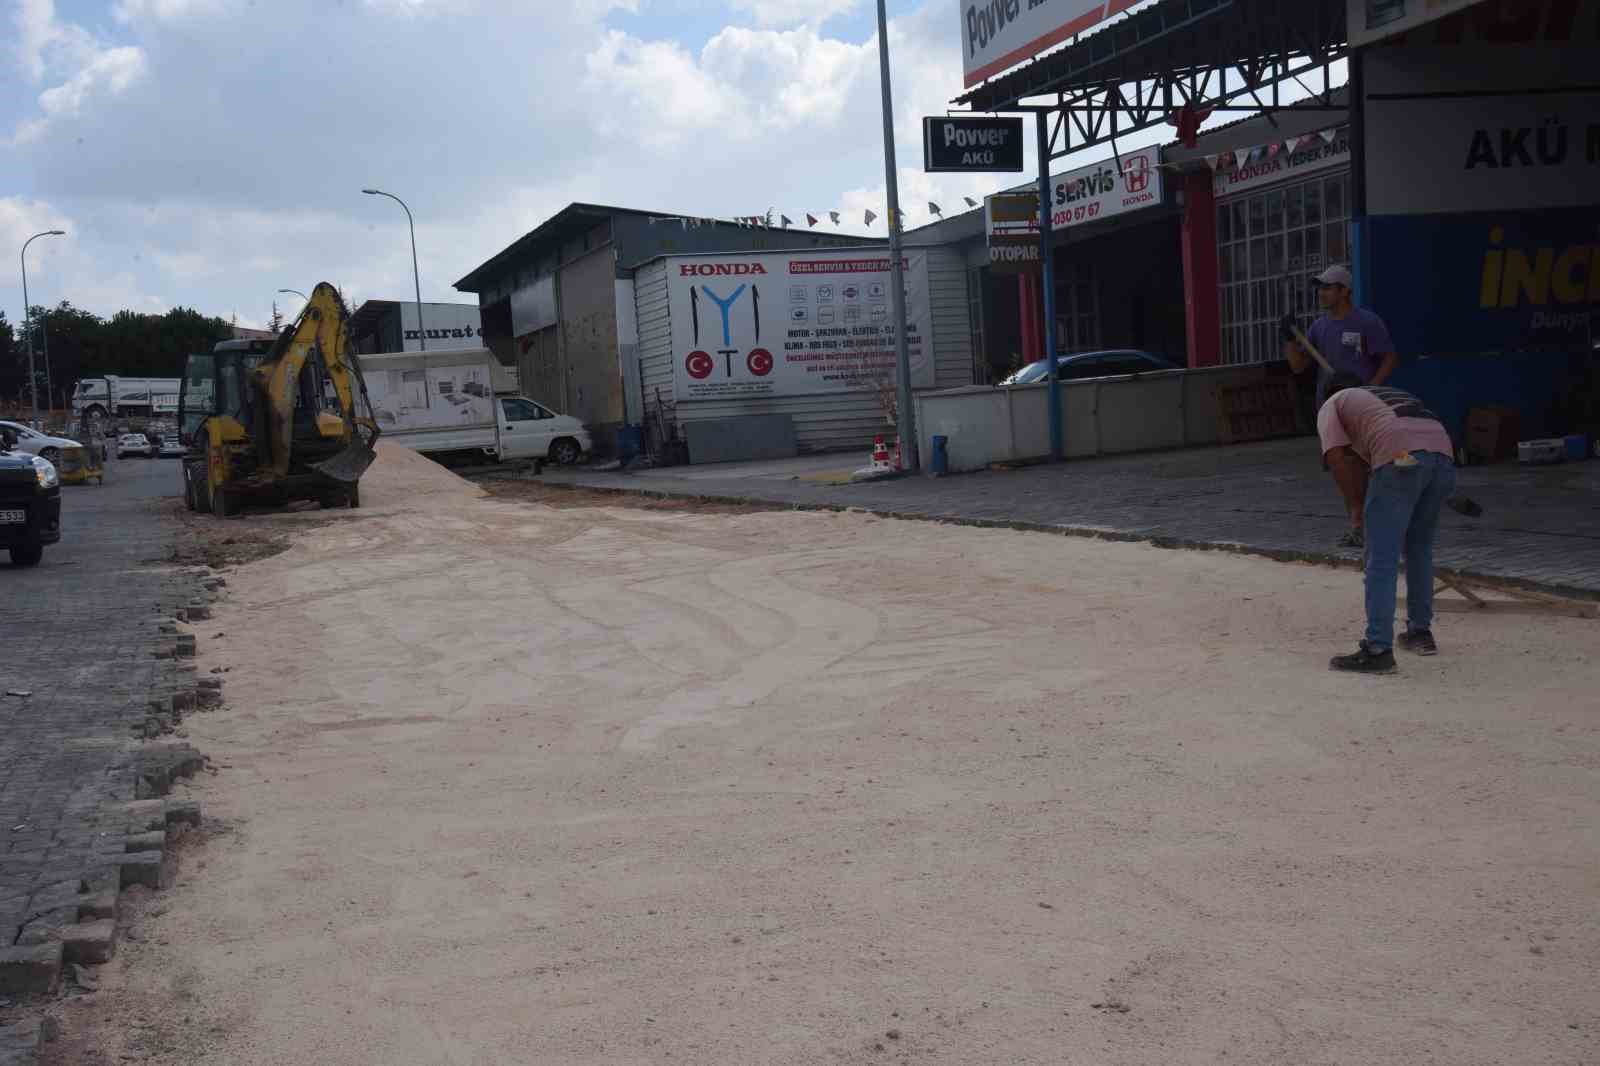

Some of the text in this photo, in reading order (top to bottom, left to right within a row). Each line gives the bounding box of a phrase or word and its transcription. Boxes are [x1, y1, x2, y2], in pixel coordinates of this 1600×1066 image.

[1464, 111, 1569, 170] AKÜ
[961, 149, 994, 165] AKÜ
[1229, 160, 1282, 184] HONDA
[1323, 138, 1350, 158] PAR
[1122, 192, 1154, 207] HONDA
[990, 245, 1040, 263] OTOPAR
[680, 263, 768, 276] HONDA
[404, 324, 474, 340] murat
